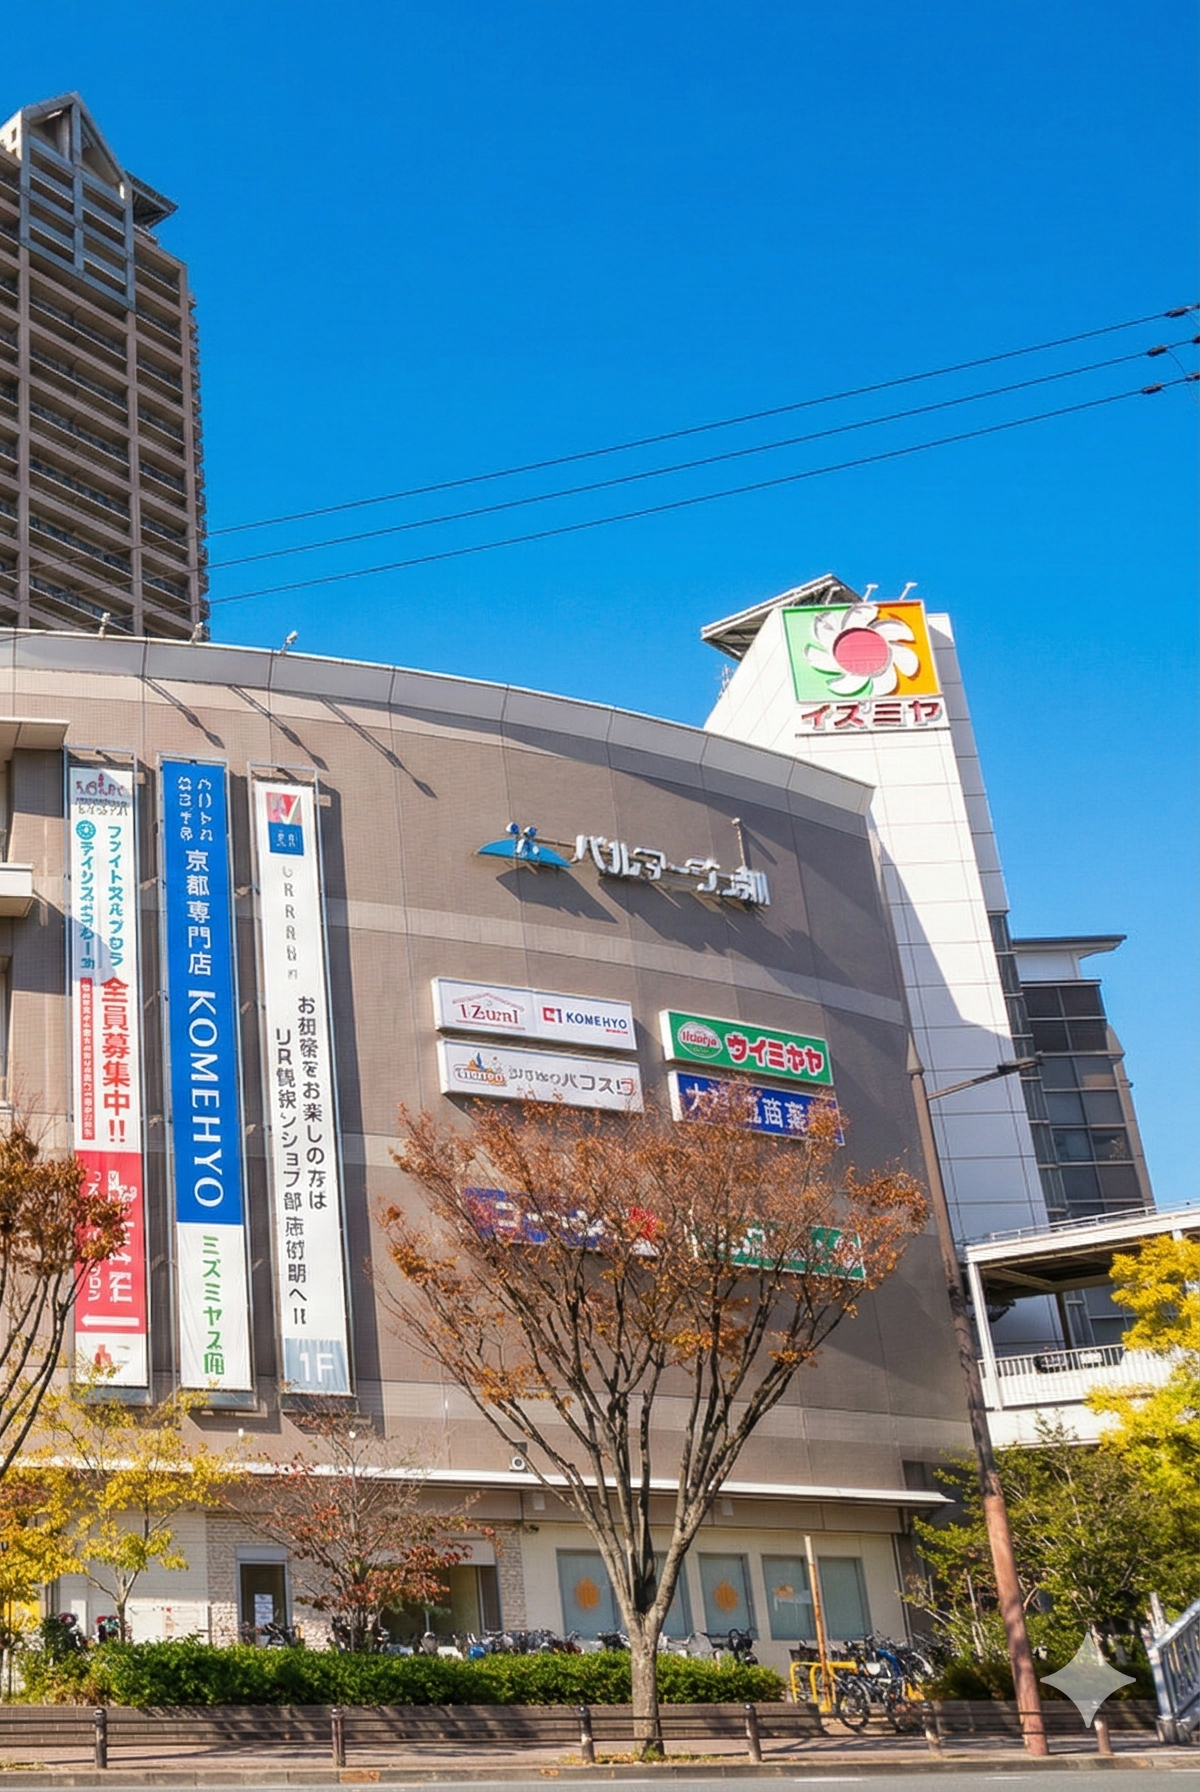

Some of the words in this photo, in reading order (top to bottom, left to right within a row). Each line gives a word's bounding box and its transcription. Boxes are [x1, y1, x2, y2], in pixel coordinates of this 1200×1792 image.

[801, 700, 942, 730] イズミヤ
[185, 848, 212, 977] 京都専門店
[566, 1011, 628, 1030] KOMEHYO
[188, 989, 224, 1208] KOMEHYO
[299, 1352, 334, 1383] 1F
